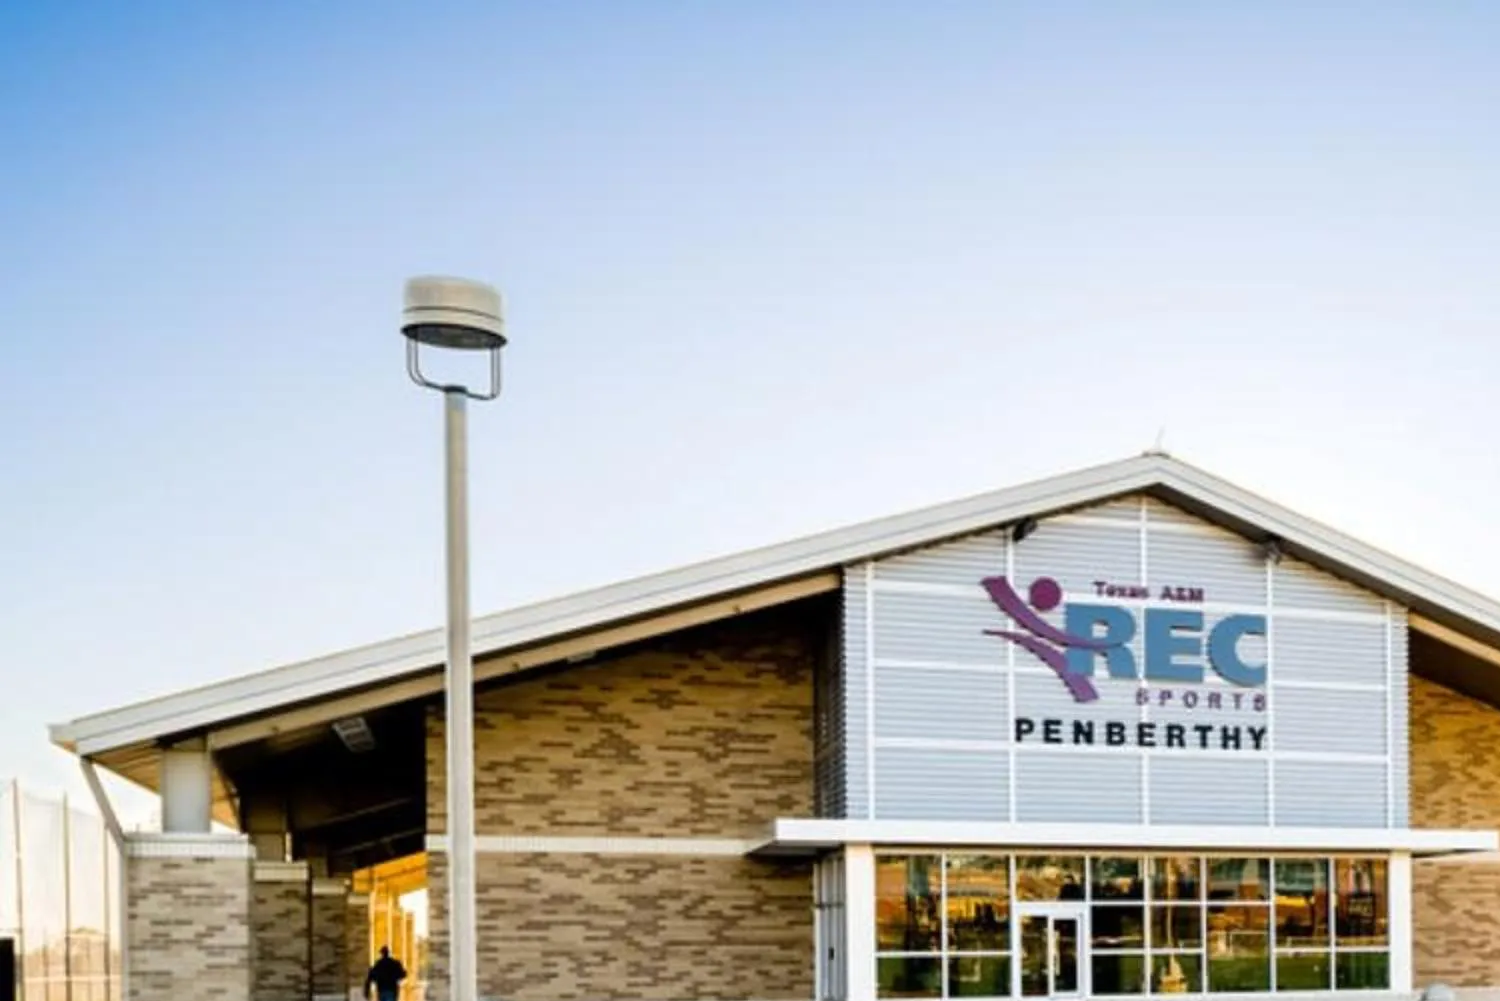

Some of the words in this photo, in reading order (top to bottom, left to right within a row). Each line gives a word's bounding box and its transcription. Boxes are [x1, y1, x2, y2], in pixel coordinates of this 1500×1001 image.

[1093, 580, 1150, 600] Texas
[1064, 602, 1267, 686] REC
[1135, 687, 1266, 712] SPORTS
[1014, 717, 1267, 751] PENBERTHY
